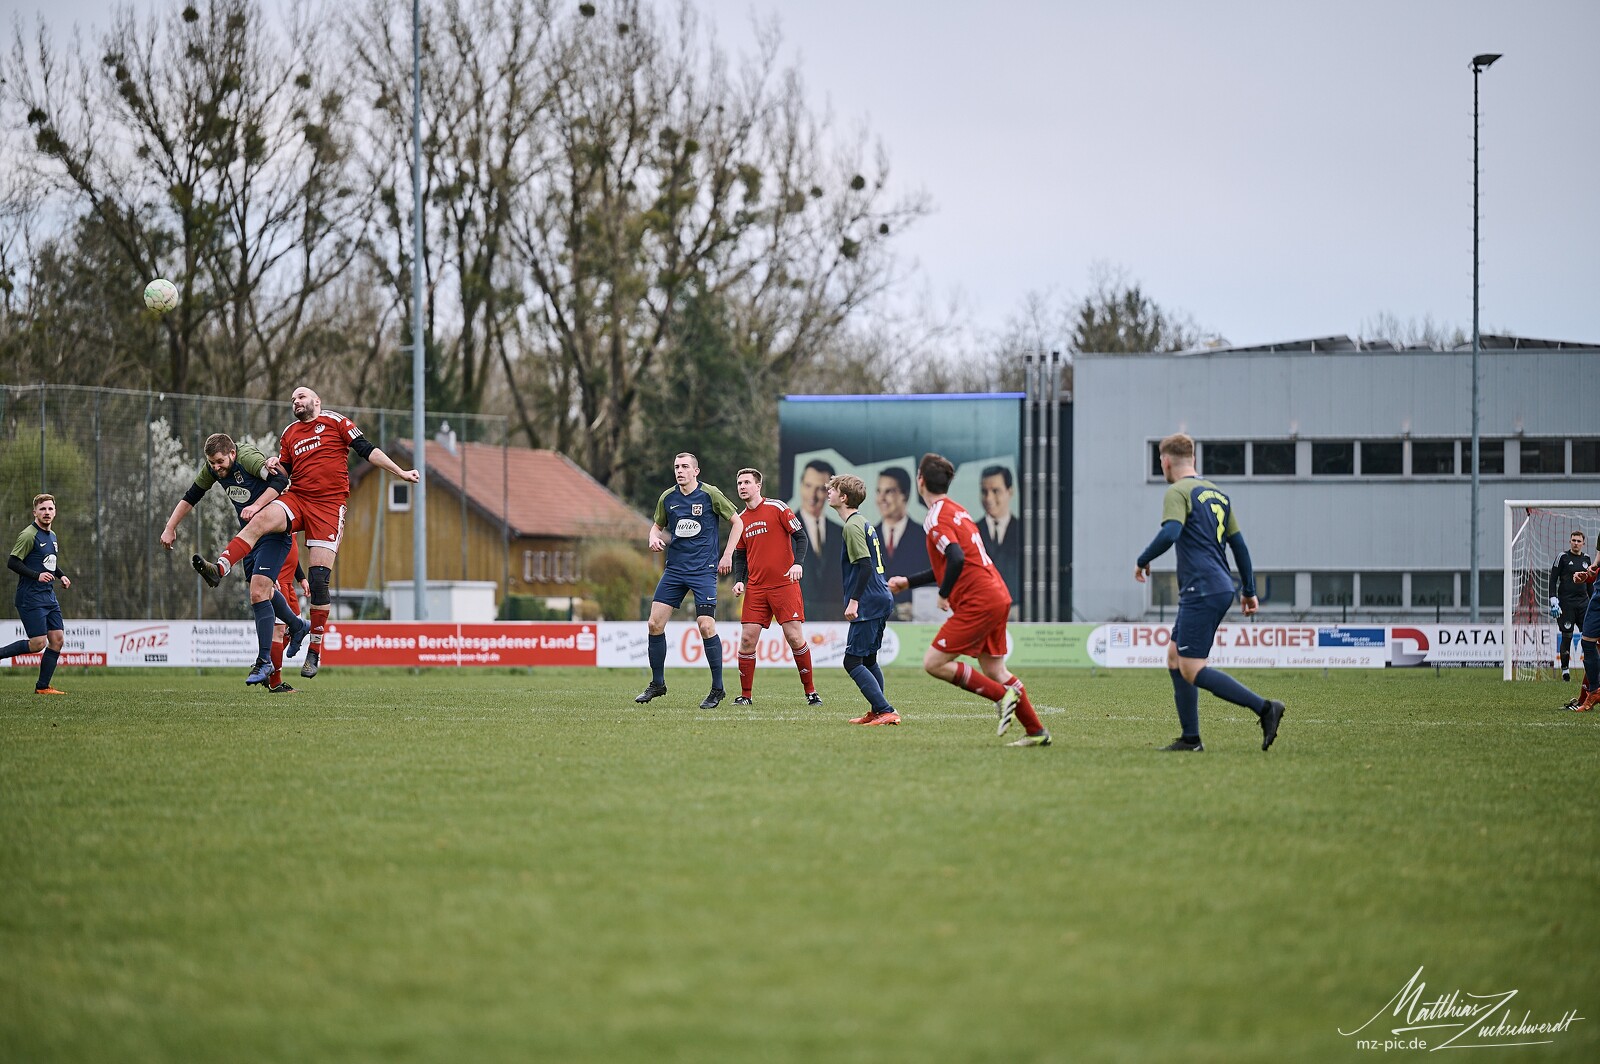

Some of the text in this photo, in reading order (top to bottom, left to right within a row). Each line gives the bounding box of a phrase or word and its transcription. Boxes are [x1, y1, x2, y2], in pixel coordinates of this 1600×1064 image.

[192, 625, 244, 637] Ausbildung
[1438, 629, 1551, 647] DATAINE
[114, 626, 169, 655] Topaz
[345, 635, 575, 652] Sparkasse Berchtesgadener Land
[1286, 656, 1324, 666] Laufener
[1328, 656, 1357, 666] Straße
[1359, 656, 1371, 666] 22
